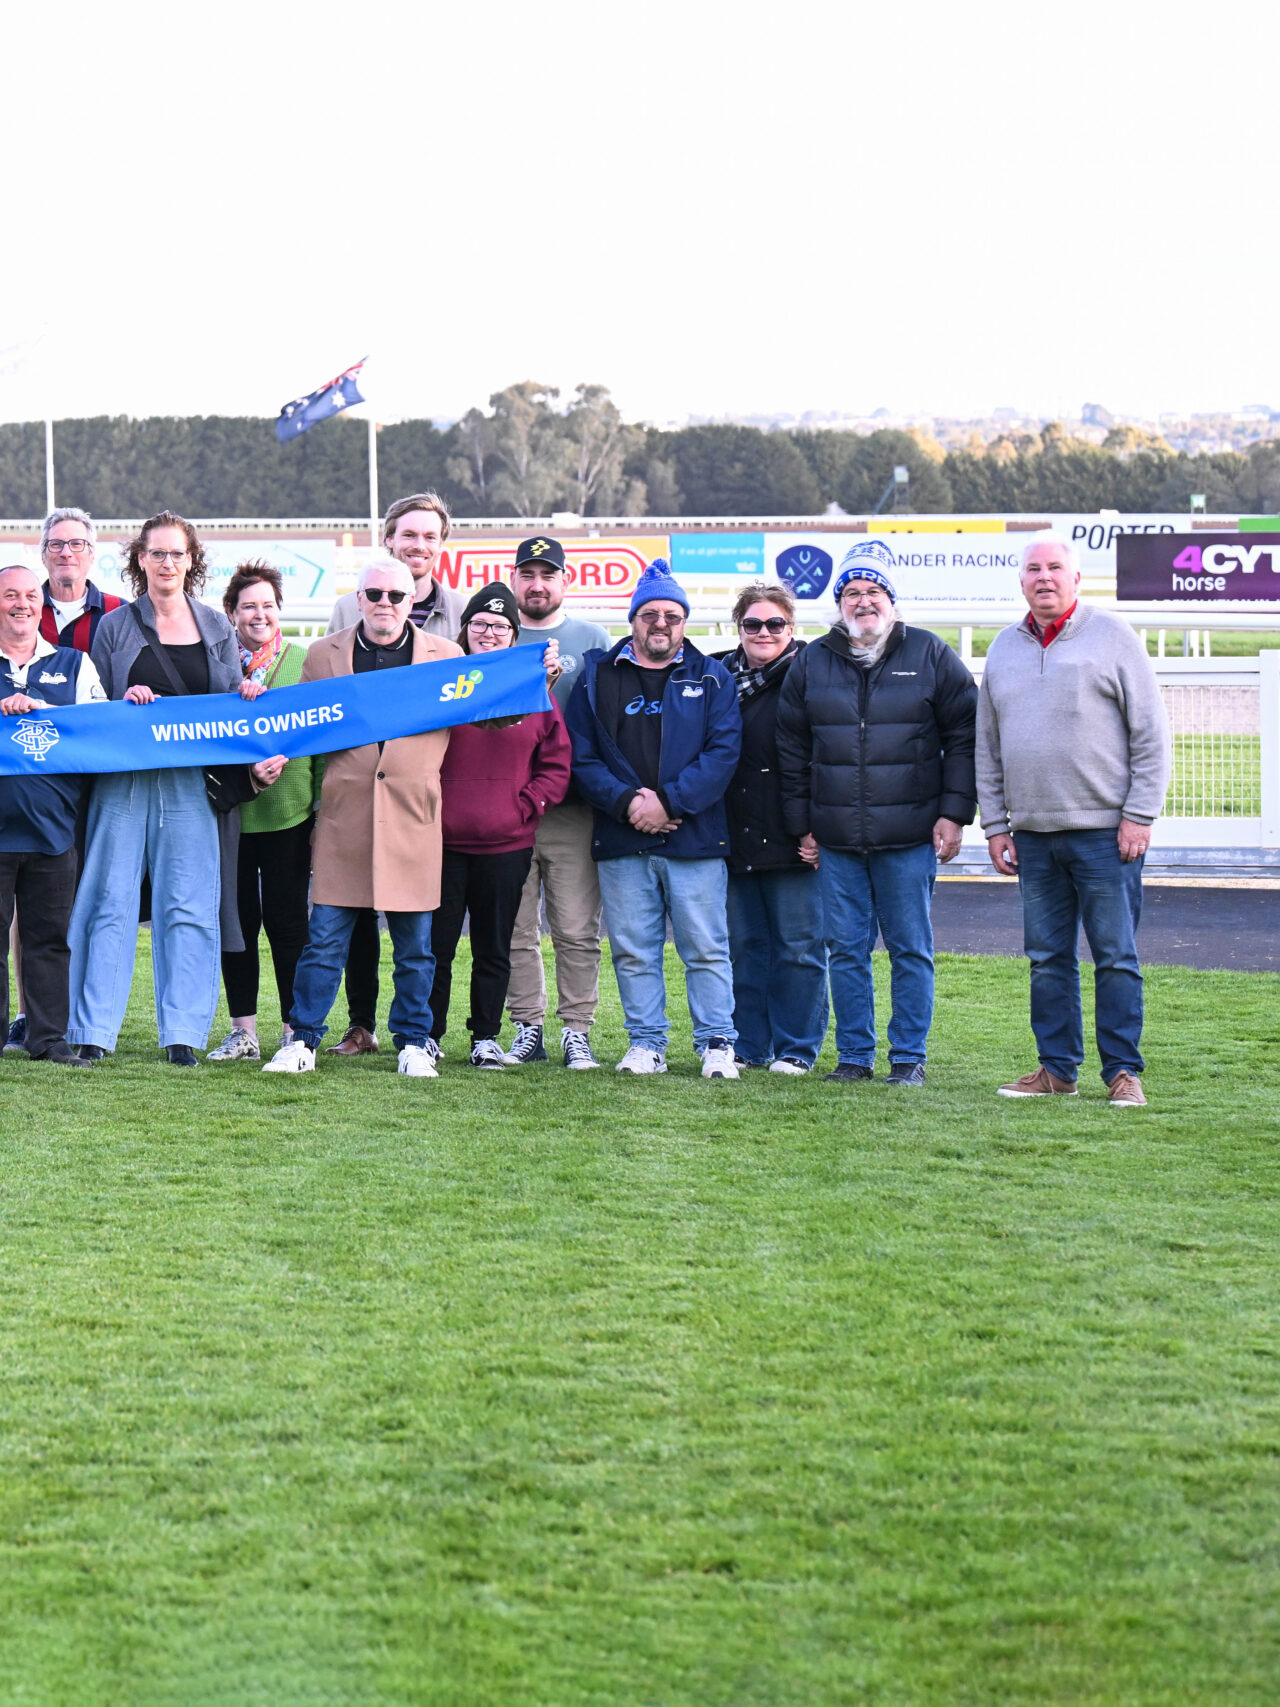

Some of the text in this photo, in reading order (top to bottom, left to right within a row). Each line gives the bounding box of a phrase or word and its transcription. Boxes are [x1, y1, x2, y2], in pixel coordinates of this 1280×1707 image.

[433, 550, 630, 590] WHITORD
[952, 554, 1019, 567] RACING
[1173, 573, 1226, 591] horse
[151, 703, 344, 742] WINNING OWNERS
